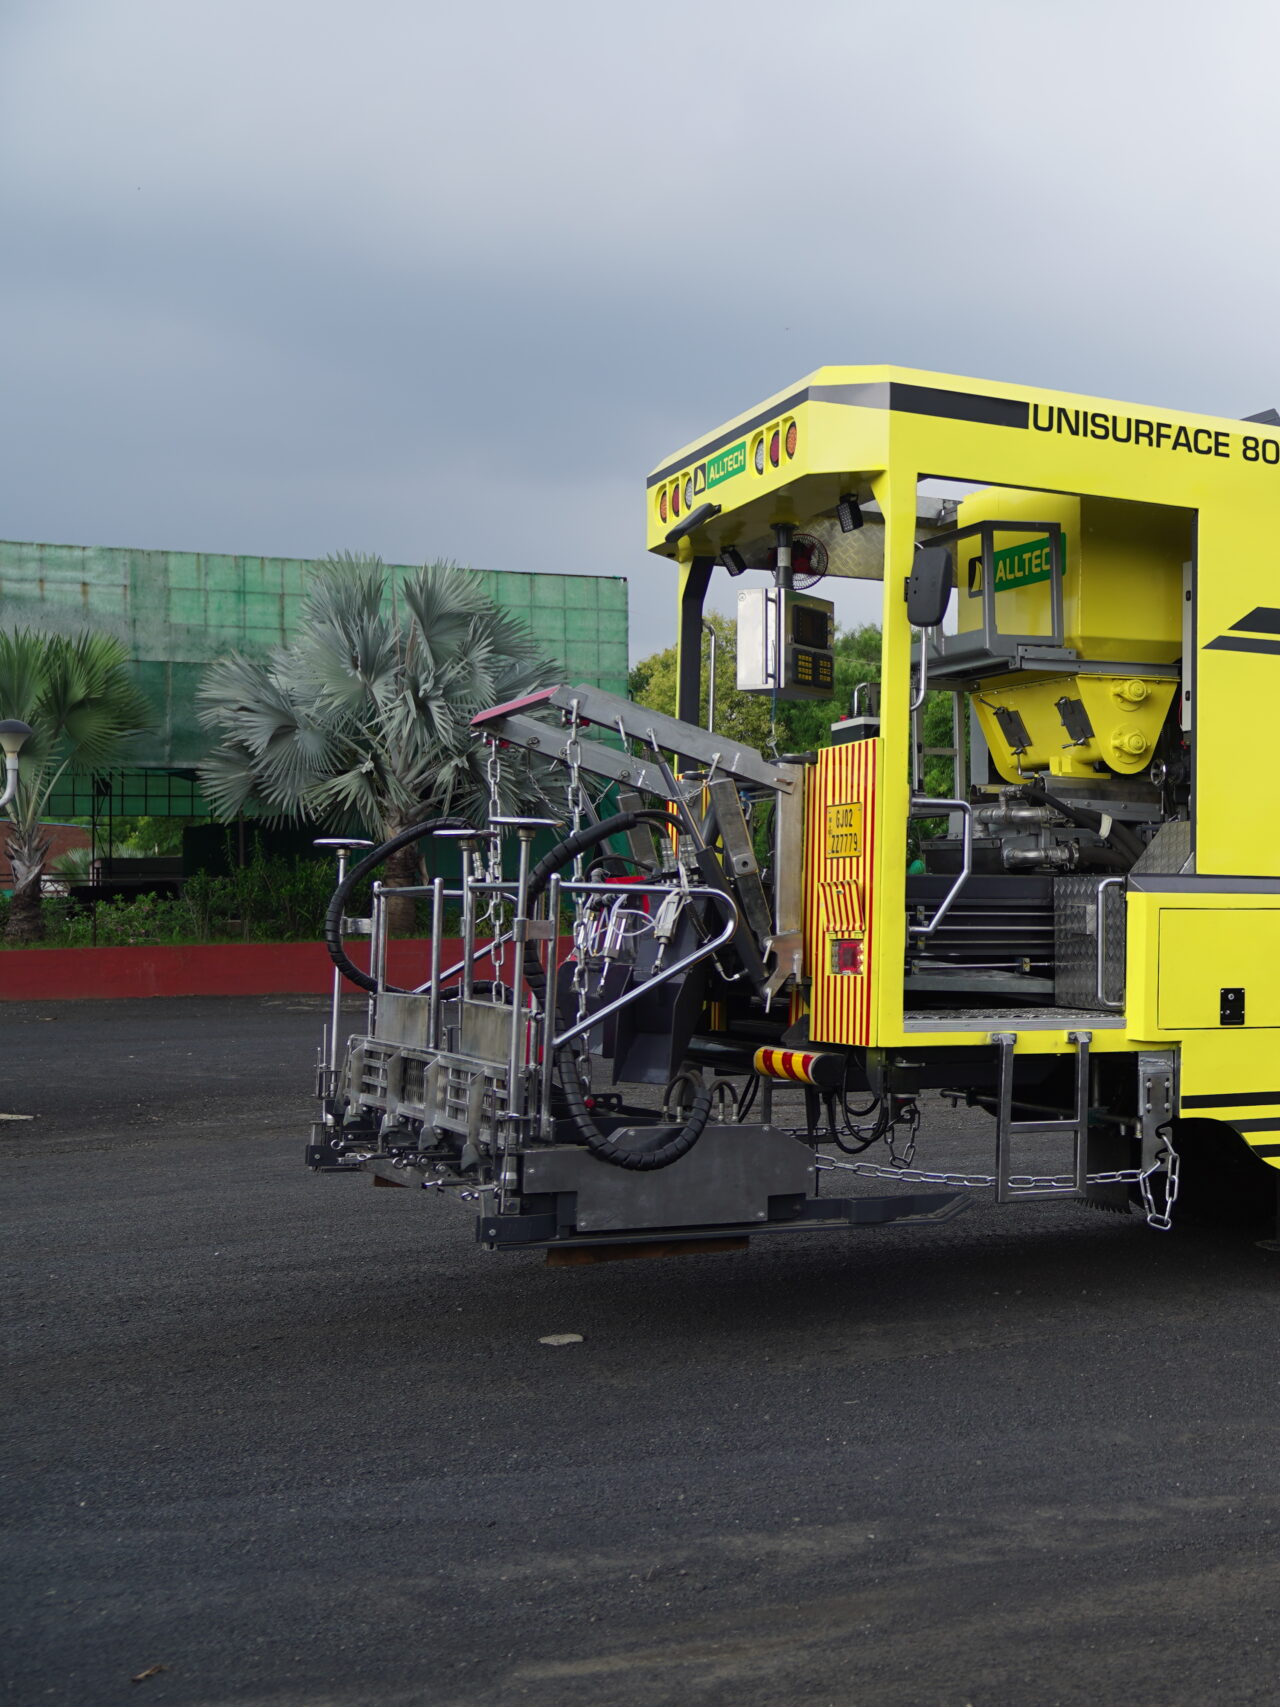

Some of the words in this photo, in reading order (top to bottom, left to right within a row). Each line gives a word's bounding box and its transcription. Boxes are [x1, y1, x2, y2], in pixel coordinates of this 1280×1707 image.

[1032, 403, 1230, 458] UNISURFACE
[709, 448, 744, 483] ALLTECH
[995, 547, 1050, 583] ALLTEC
[836, 808, 853, 828] GJ02
[831, 832, 858, 854] ZZ7779
